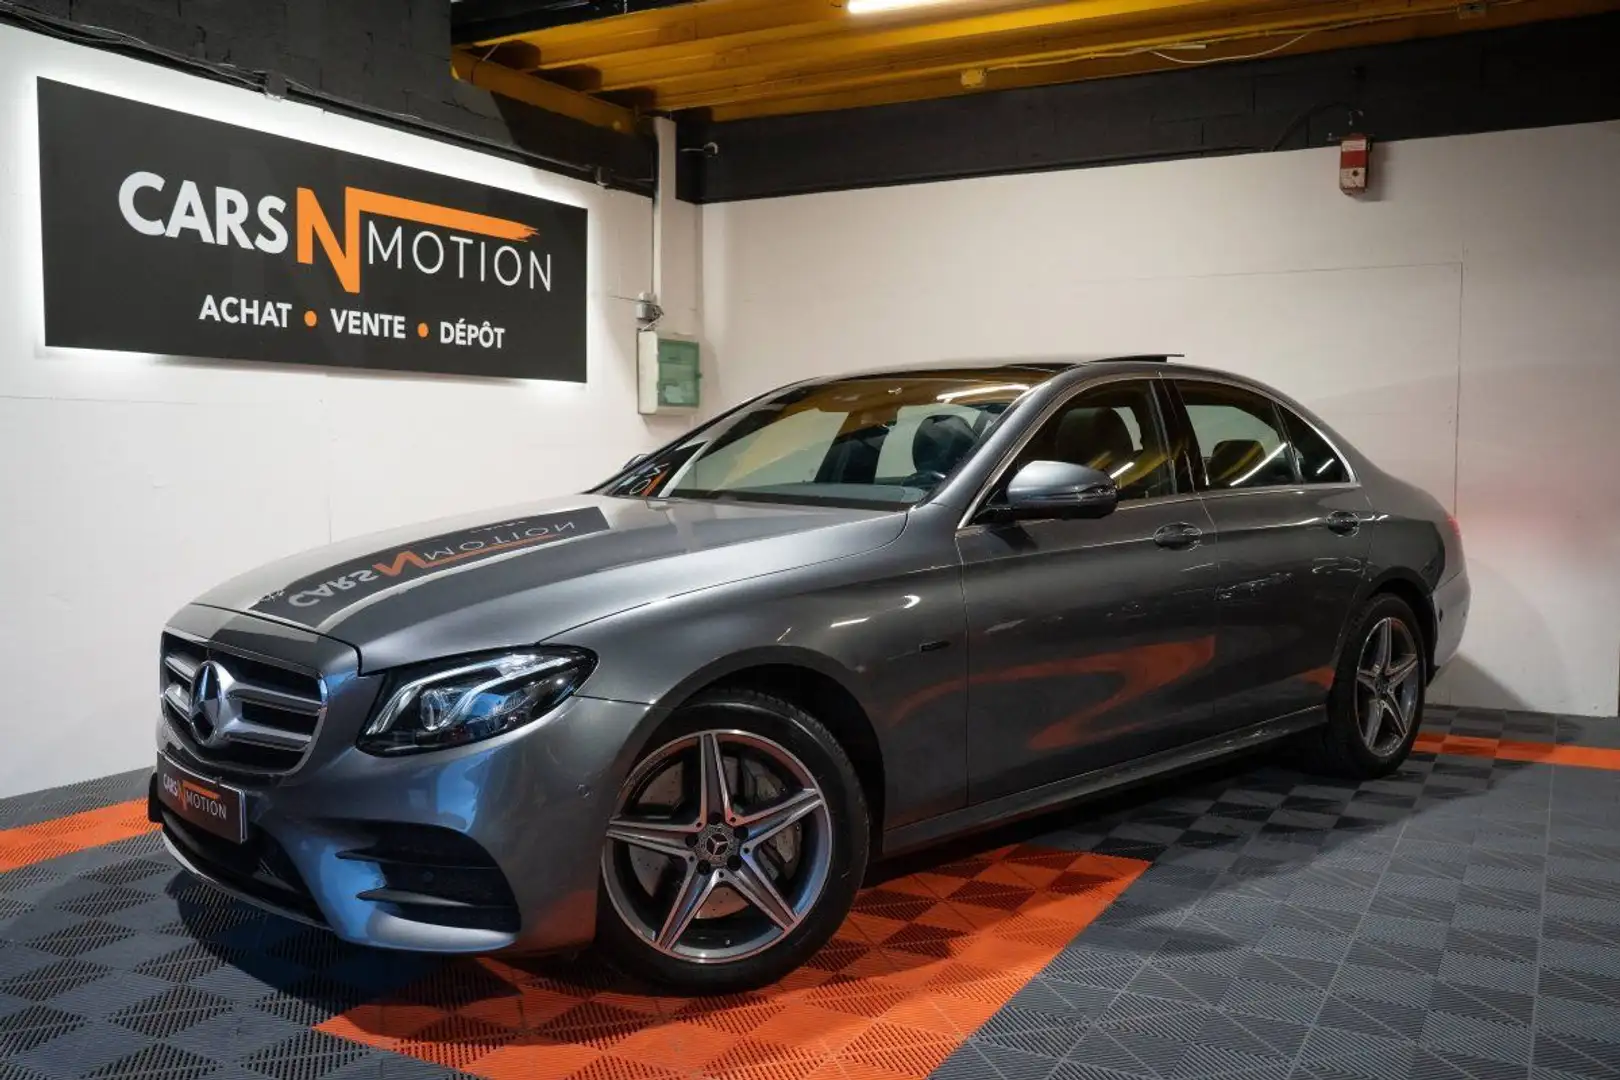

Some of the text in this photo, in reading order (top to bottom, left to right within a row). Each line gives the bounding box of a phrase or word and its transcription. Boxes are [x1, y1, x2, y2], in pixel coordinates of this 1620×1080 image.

[119, 171, 289, 255] CARS
[368, 220, 552, 292] MOTION
[199, 294, 506, 349] ACHAT VENTE DÉPÔT
[186, 792, 227, 820] MOTION
